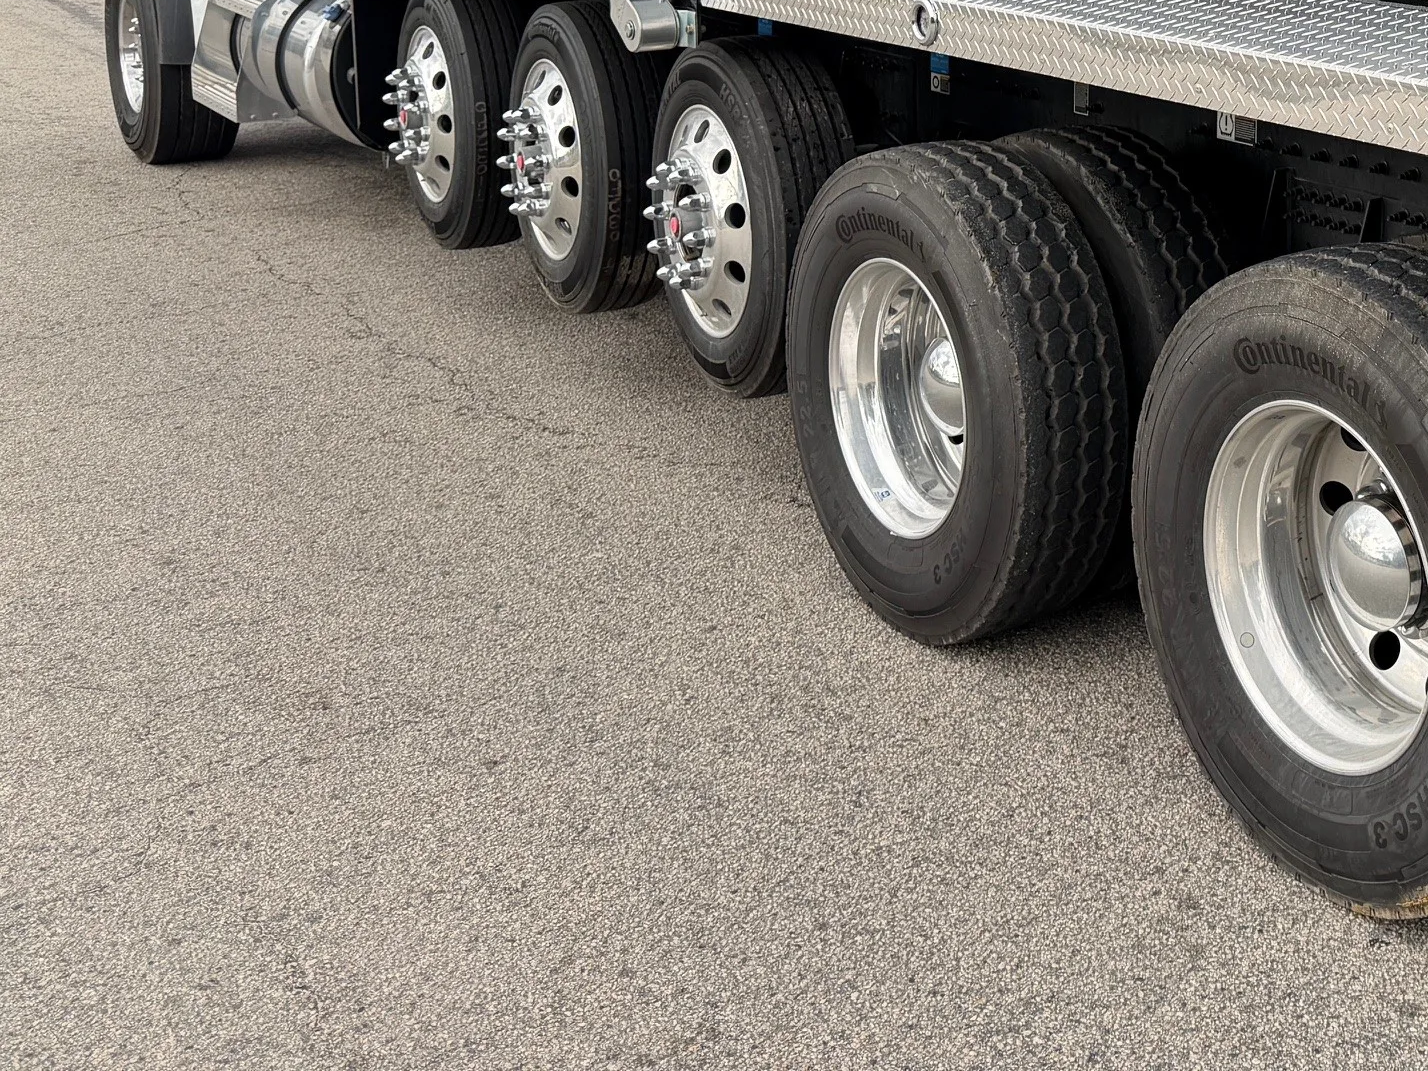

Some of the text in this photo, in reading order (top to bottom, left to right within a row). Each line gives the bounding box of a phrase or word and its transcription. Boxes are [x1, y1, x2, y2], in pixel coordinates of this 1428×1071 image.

[836, 207, 915, 254] Continental
[1233, 335, 1371, 412] Continental
[1373, 821, 1388, 849] 3
